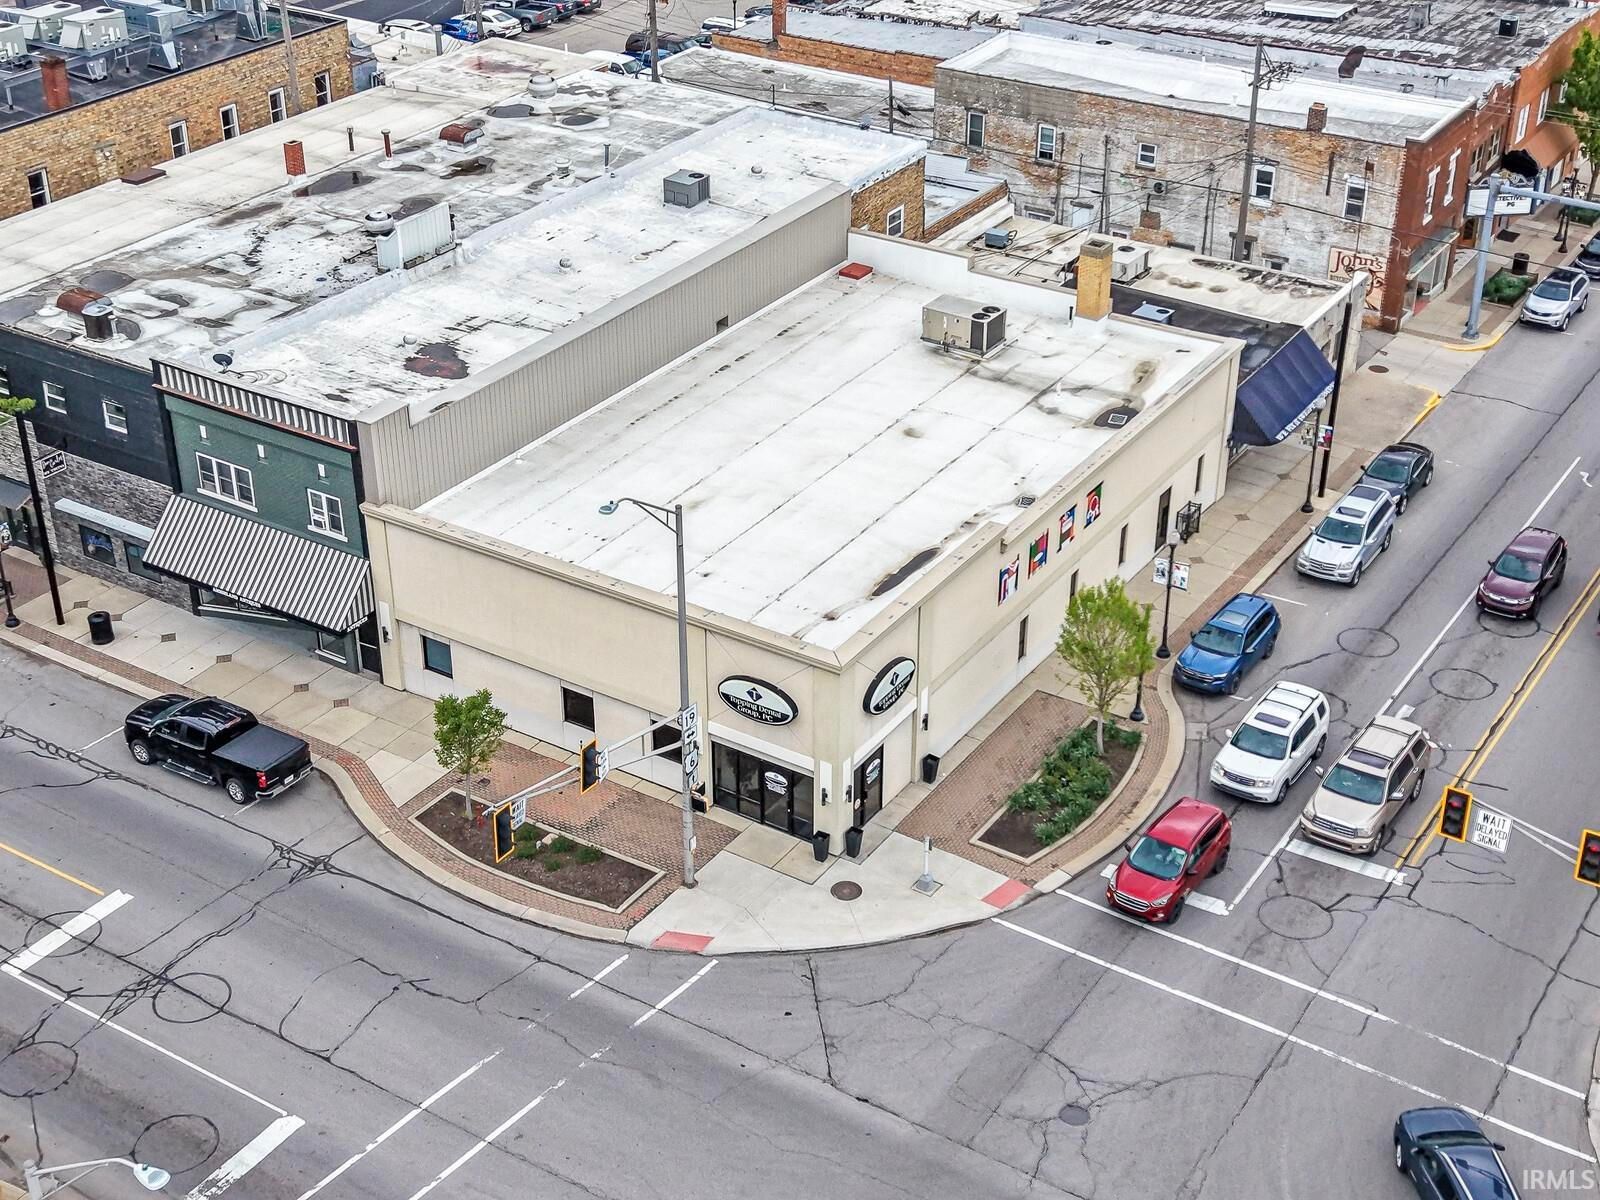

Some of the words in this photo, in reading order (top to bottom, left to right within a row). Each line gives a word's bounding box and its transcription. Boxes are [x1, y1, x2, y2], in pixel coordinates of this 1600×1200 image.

[1330, 251, 1383, 273] John's
[729, 695, 758, 712] Topping
[759, 704, 782, 719] Dental
[683, 712, 695, 727] 19
[762, 713, 774, 722] PC
[689, 756, 695, 767] 6
[1483, 812, 1506, 829] WAIT
[1475, 822, 1508, 841] DELAYED
[1477, 833, 1501, 849] SIGNAL
